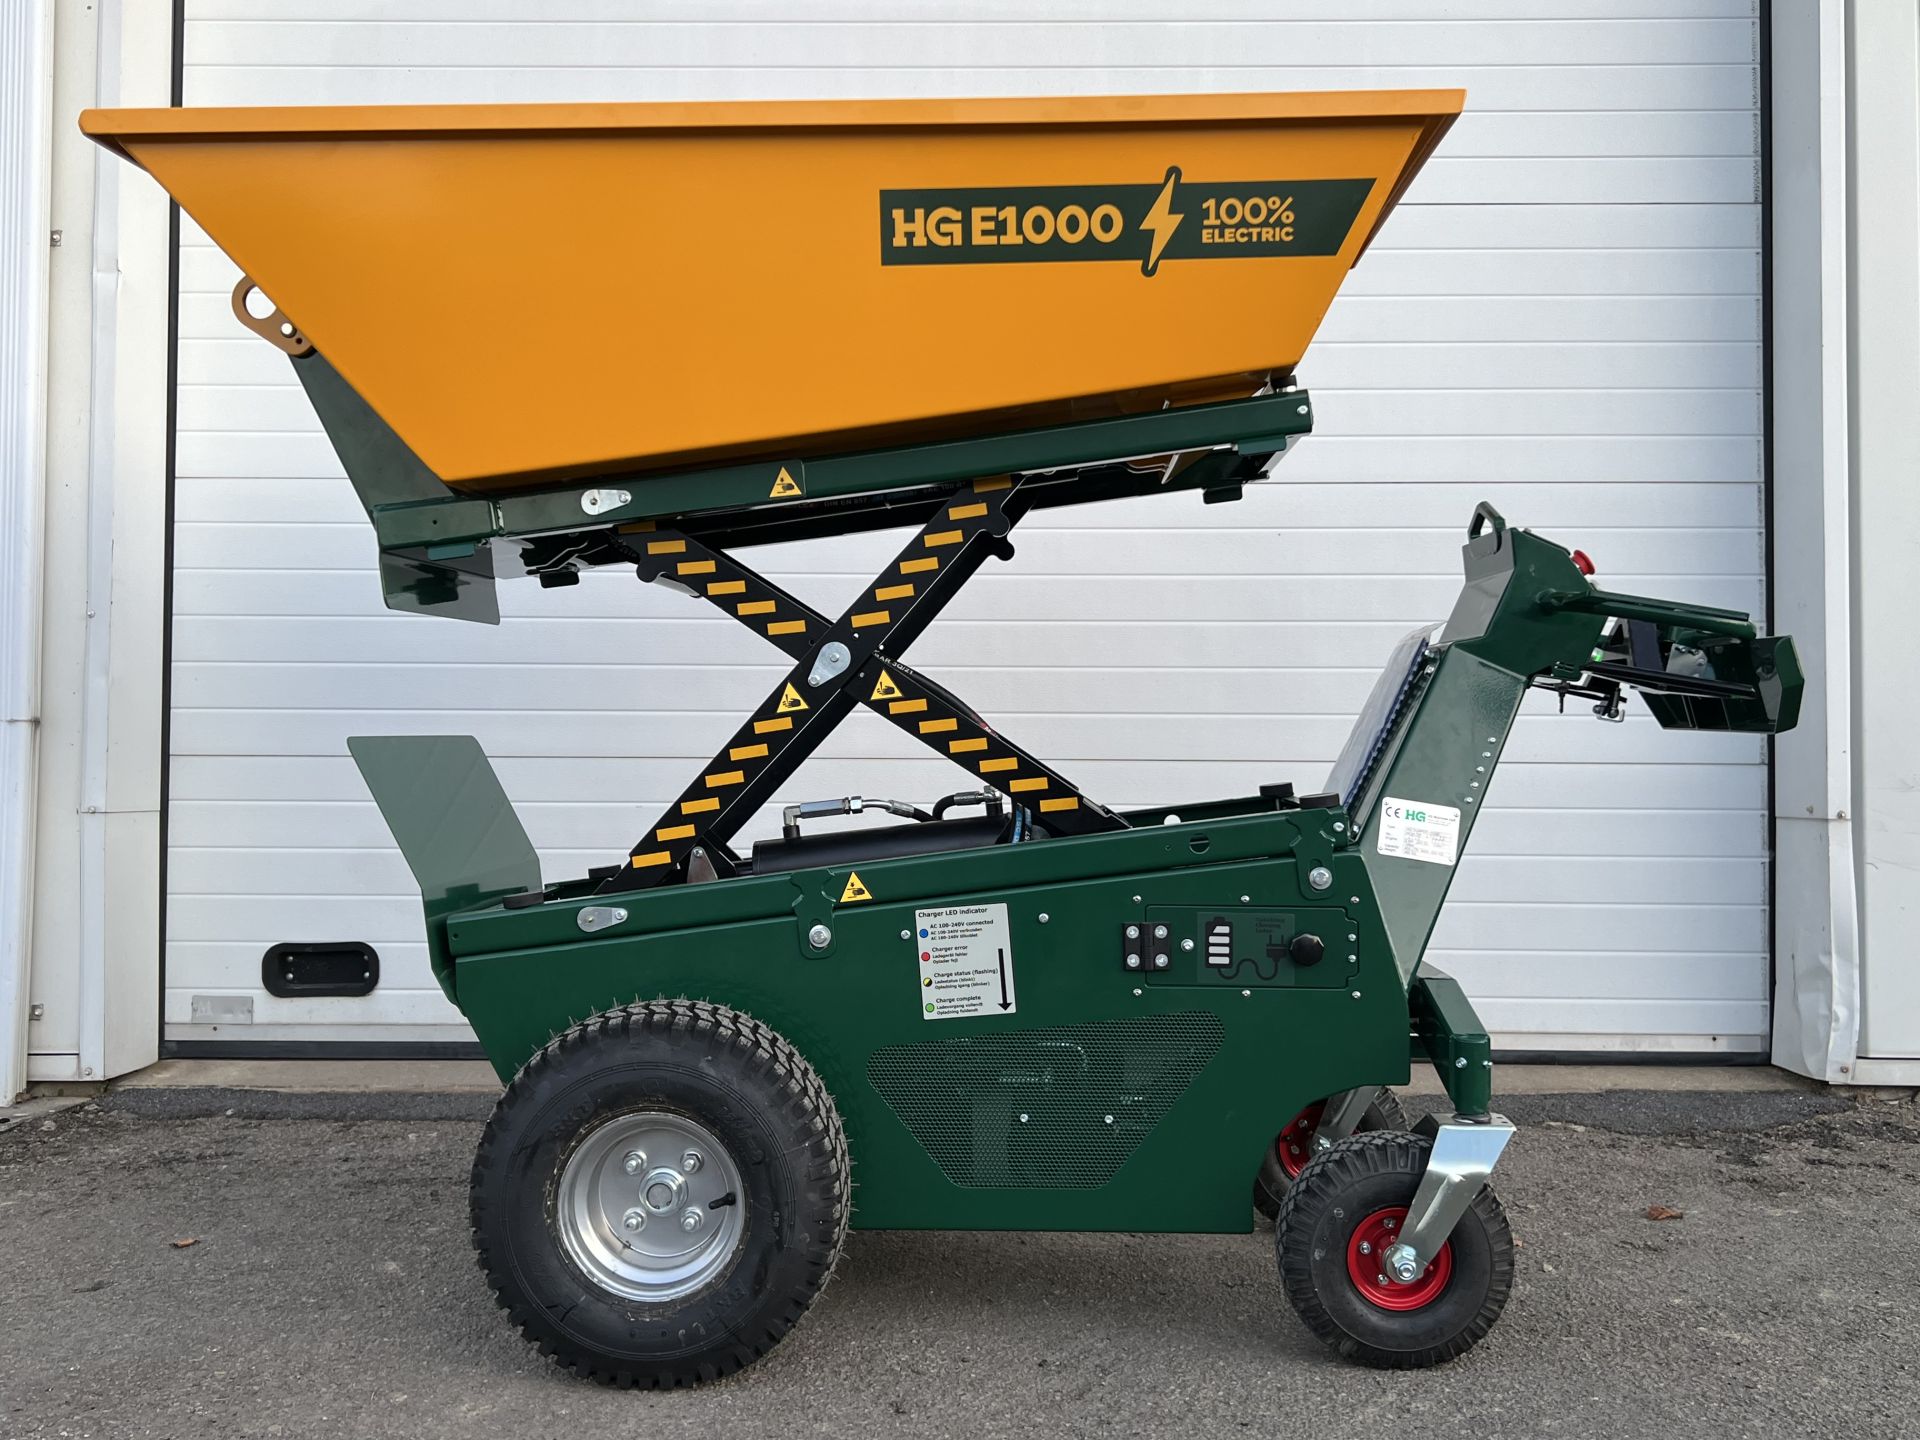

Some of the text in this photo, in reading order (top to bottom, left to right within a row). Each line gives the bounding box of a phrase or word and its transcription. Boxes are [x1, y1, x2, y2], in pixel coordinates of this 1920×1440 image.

[1201, 195, 1295, 226] 100%
[891, 204, 1124, 248] HG E1000
[1201, 225, 1295, 244] ELECTRIC
[892, 661, 914, 675] 3Q/21
[1404, 809, 1427, 823] HG
[918, 911, 944, 919] Charger
[972, 967, 998, 976] (flashing)
